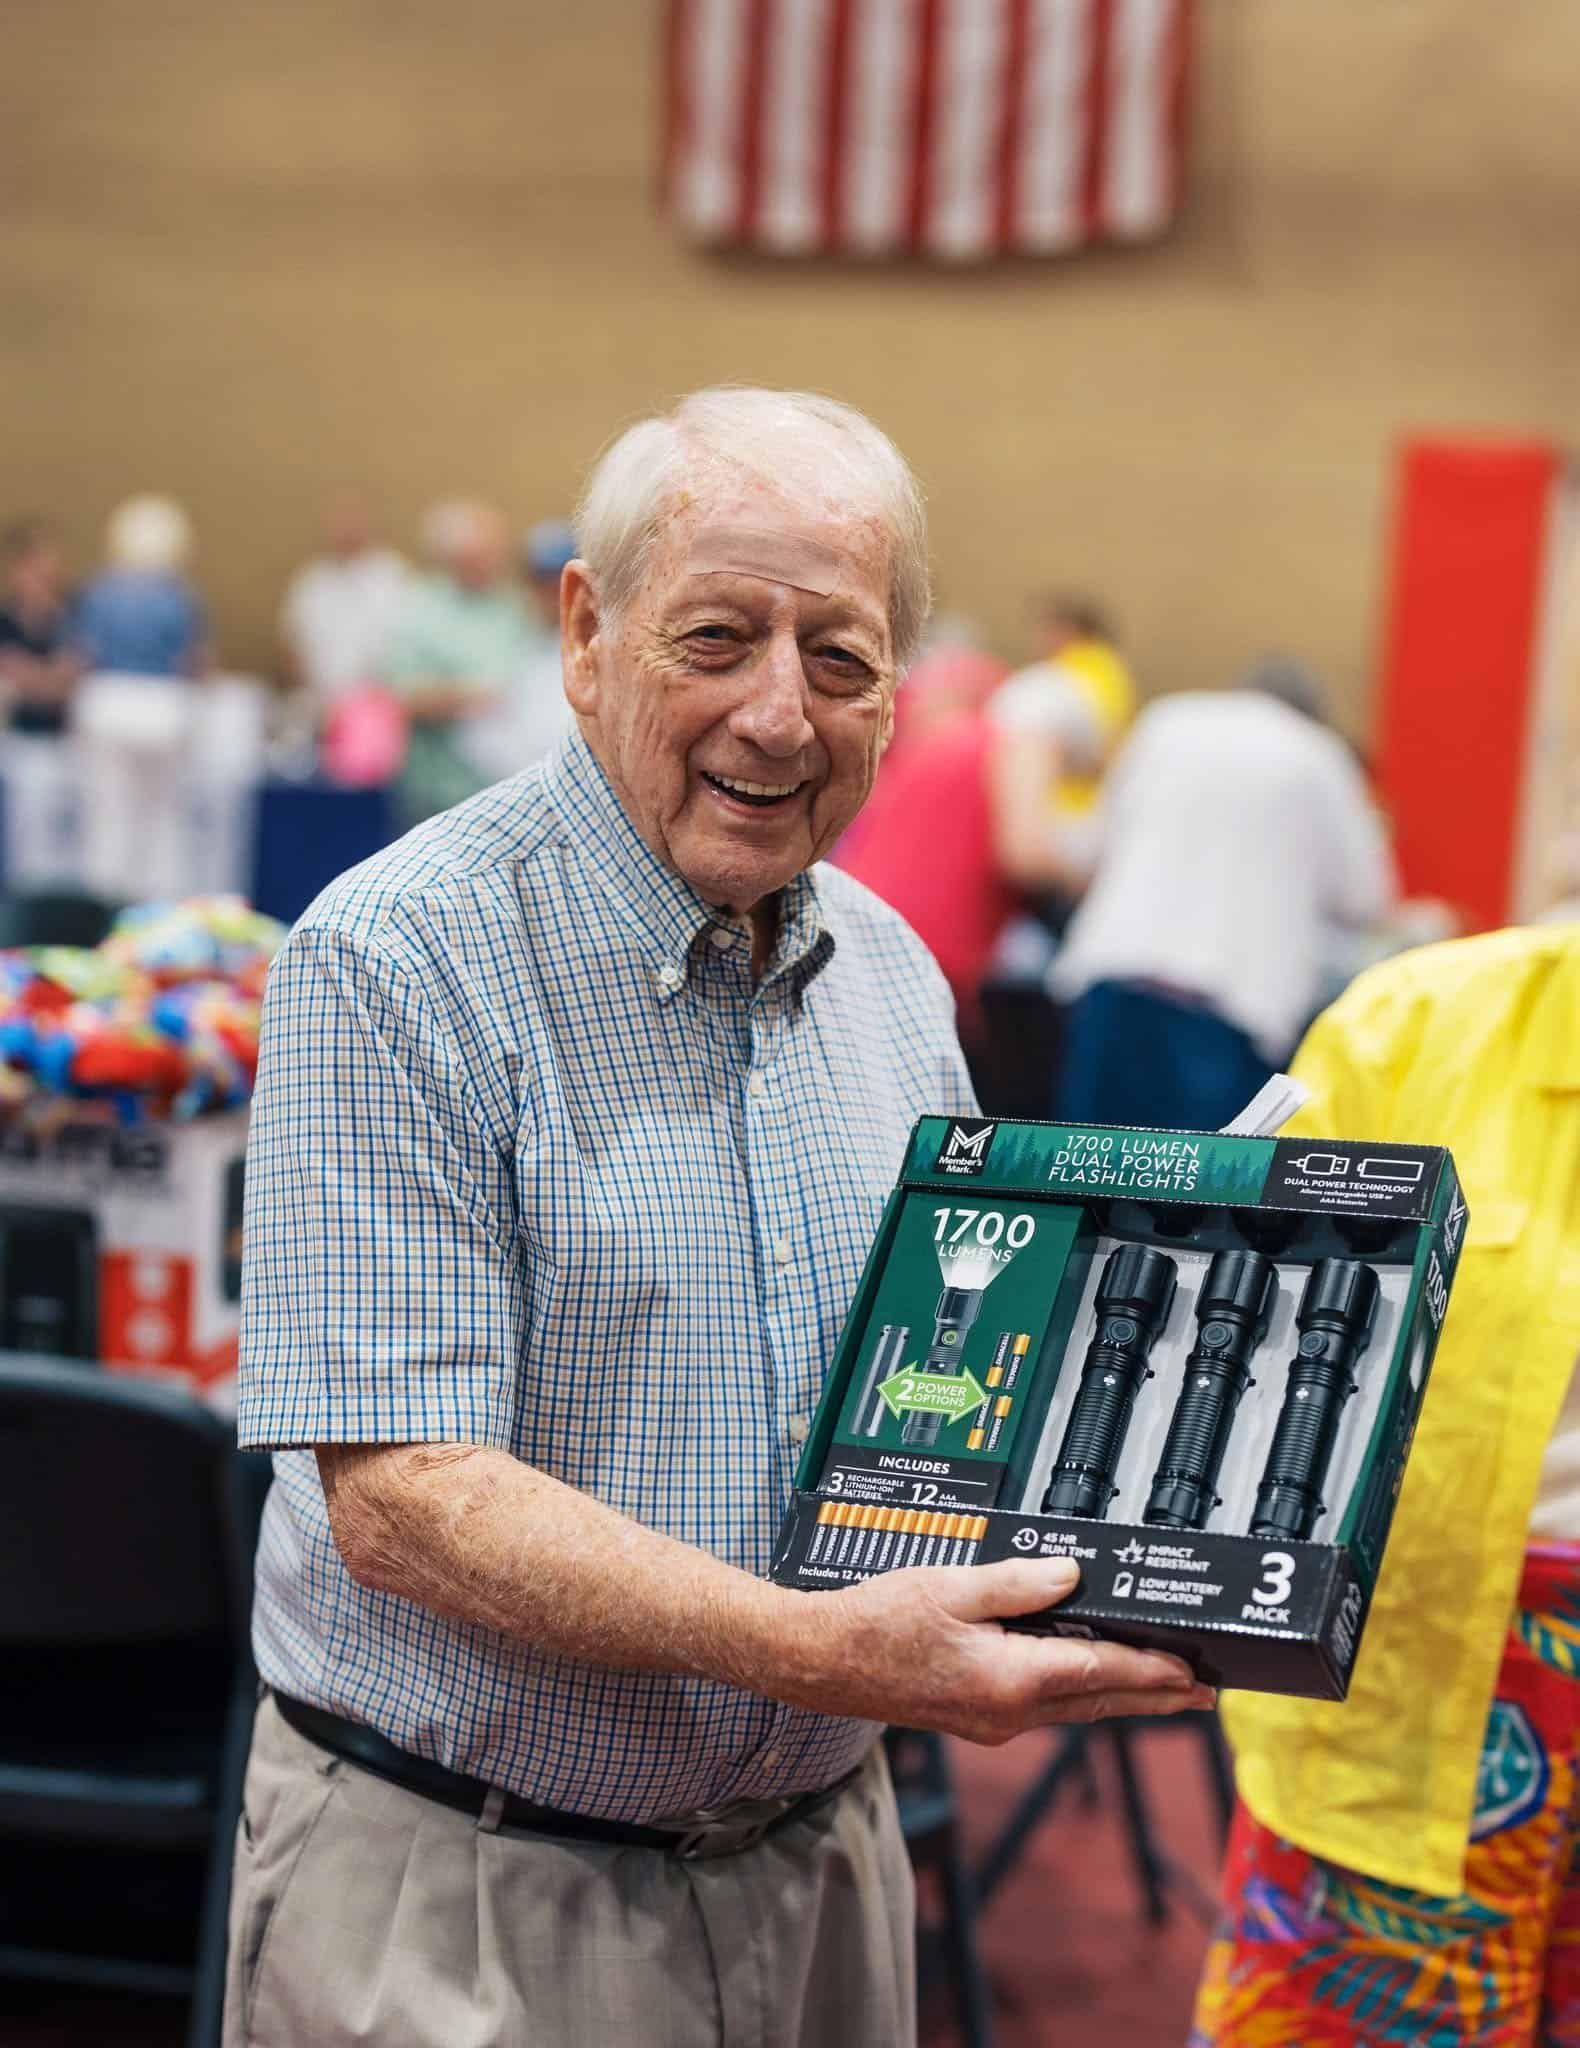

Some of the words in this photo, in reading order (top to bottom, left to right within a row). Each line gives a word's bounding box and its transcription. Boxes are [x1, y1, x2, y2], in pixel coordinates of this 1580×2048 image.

[1066, 1136, 1113, 1152] 1700
[1121, 1138, 1199, 1157] LUMEN
[1055, 1151, 1111, 1169] DUAL
[1121, 1156, 1199, 1175] POWER
[1048, 1167, 1196, 1191] FLASHLIGHTS
[1284, 1178, 1310, 1187] DUAL
[1312, 1180, 1346, 1190] POWER
[1349, 1182, 1416, 1194] TECHNOLOGY
[934, 1208, 1036, 1248] 1700
[895, 1379, 916, 1401] 2
[916, 1382, 967, 1396] POWER
[913, 1394, 965, 1407] OPTIONS
[878, 1455, 951, 1474] INCLUDES
[827, 1472, 845, 1493] 3
[847, 1474, 905, 1488] RECHARGEABLE
[845, 1482, 895, 1494] LITHIUM-ION
[911, 1483, 938, 1505] 12
[1060, 1534, 1078, 1545] HR
[1039, 1543, 1068, 1555] RUN
[1068, 1546, 1098, 1559] TIME
[1147, 1544, 1195, 1558] IMPACT
[798, 1565, 840, 1579] Includes
[842, 1569, 853, 1580] 12
[1144, 1556, 1211, 1573] RESISTANT
[1138, 1577, 1169, 1590] LOW
[1168, 1580, 1224, 1597] BATTERY
[1251, 1552, 1296, 1606] 3
[1135, 1589, 1203, 1607] INDICATOR
[1241, 1604, 1293, 1625] PACK
